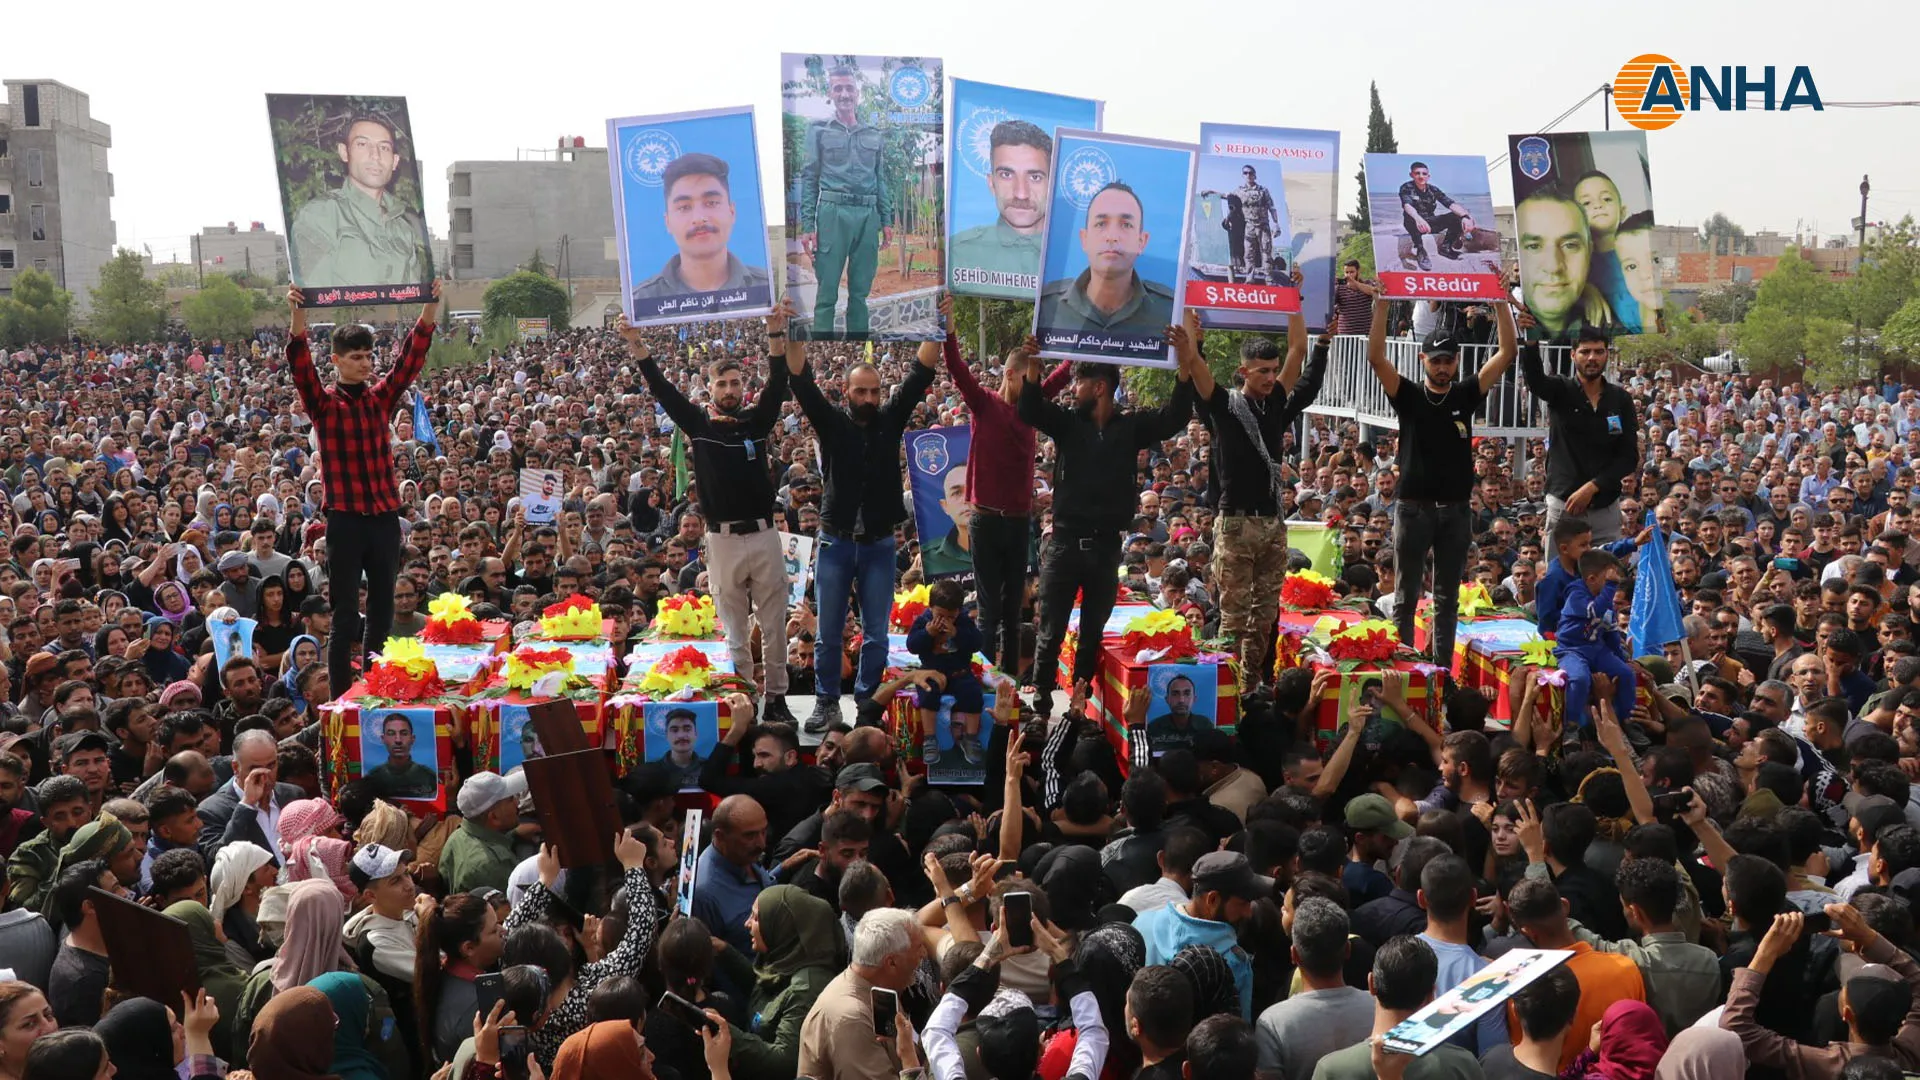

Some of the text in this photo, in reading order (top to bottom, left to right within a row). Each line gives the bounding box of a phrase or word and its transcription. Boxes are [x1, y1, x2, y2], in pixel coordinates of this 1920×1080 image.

[1405, 276, 1480, 294] Ş.Rêdûr
[679, 297, 699, 312] ناظم
[719, 290, 747, 306] الشهيد
[1206, 286, 1277, 305] Ş.Rêdûr
[1044, 332, 1160, 352] الشهيد بسام حاكم الحسين
